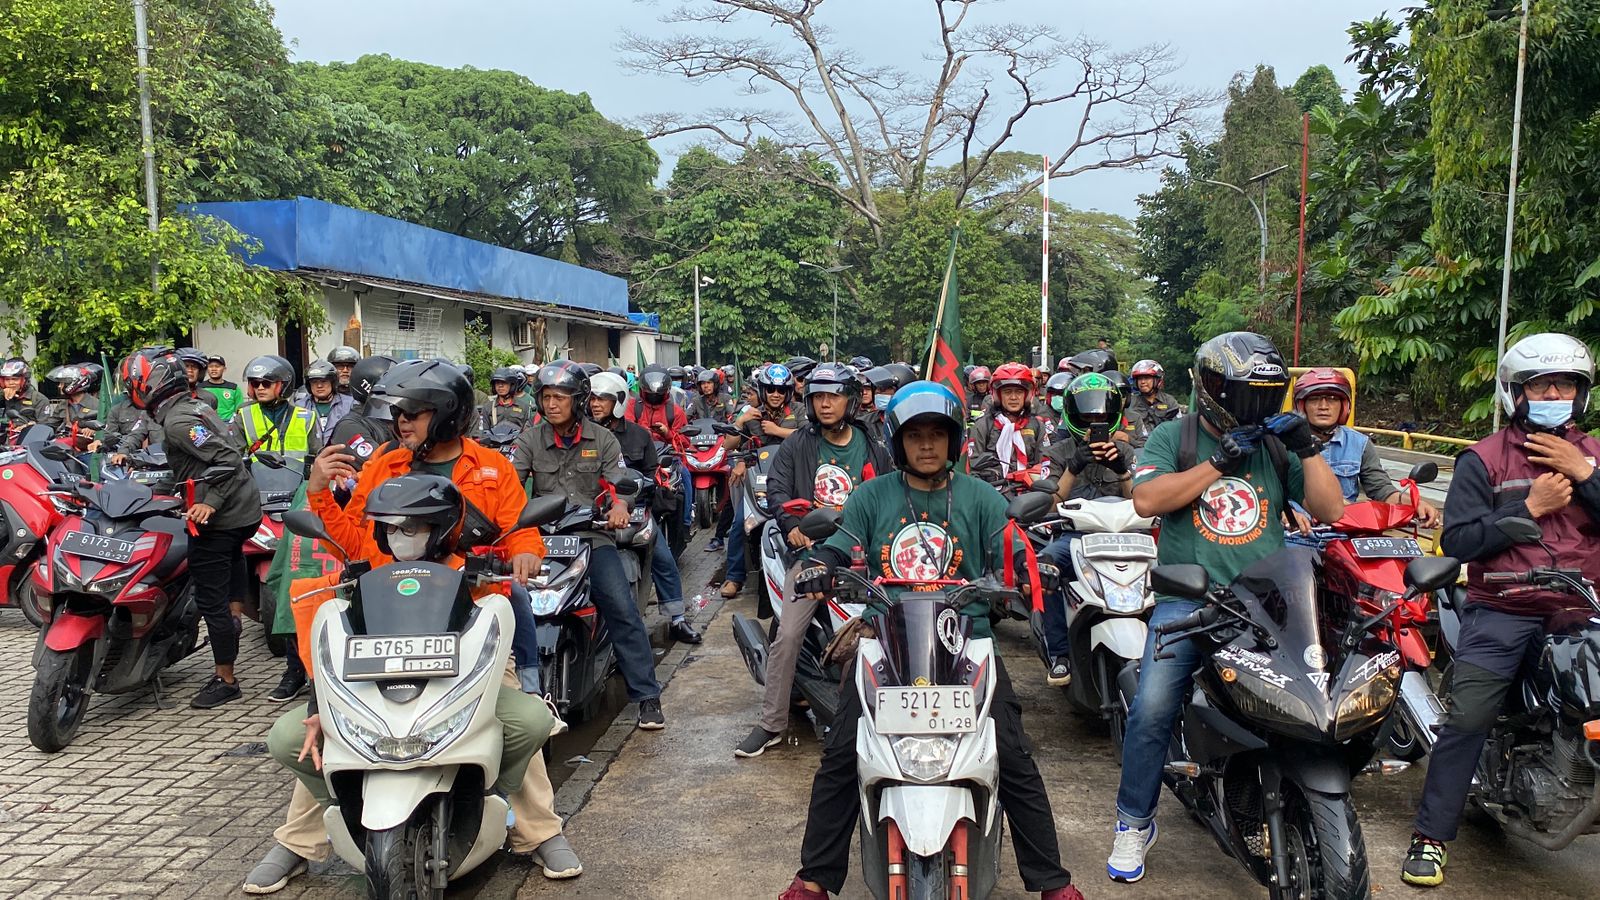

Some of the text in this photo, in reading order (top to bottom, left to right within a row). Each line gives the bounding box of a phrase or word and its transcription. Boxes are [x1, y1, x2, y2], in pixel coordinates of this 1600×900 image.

[1199, 525, 1218, 542] THE
[1218, 527, 1263, 545] WORKING
[1258, 498, 1269, 528] CLASS
[65, 532, 135, 553] F 6175 DY
[564, 537, 578, 547] DT
[1354, 541, 1362, 549] F
[1366, 539, 1394, 548] 6359
[881, 544, 891, 561] WE
[948, 549, 964, 576] CLASS
[881, 562, 895, 579] ARE
[353, 638, 453, 658] F 6765 FDC
[878, 690, 971, 711] F 5212 EC
